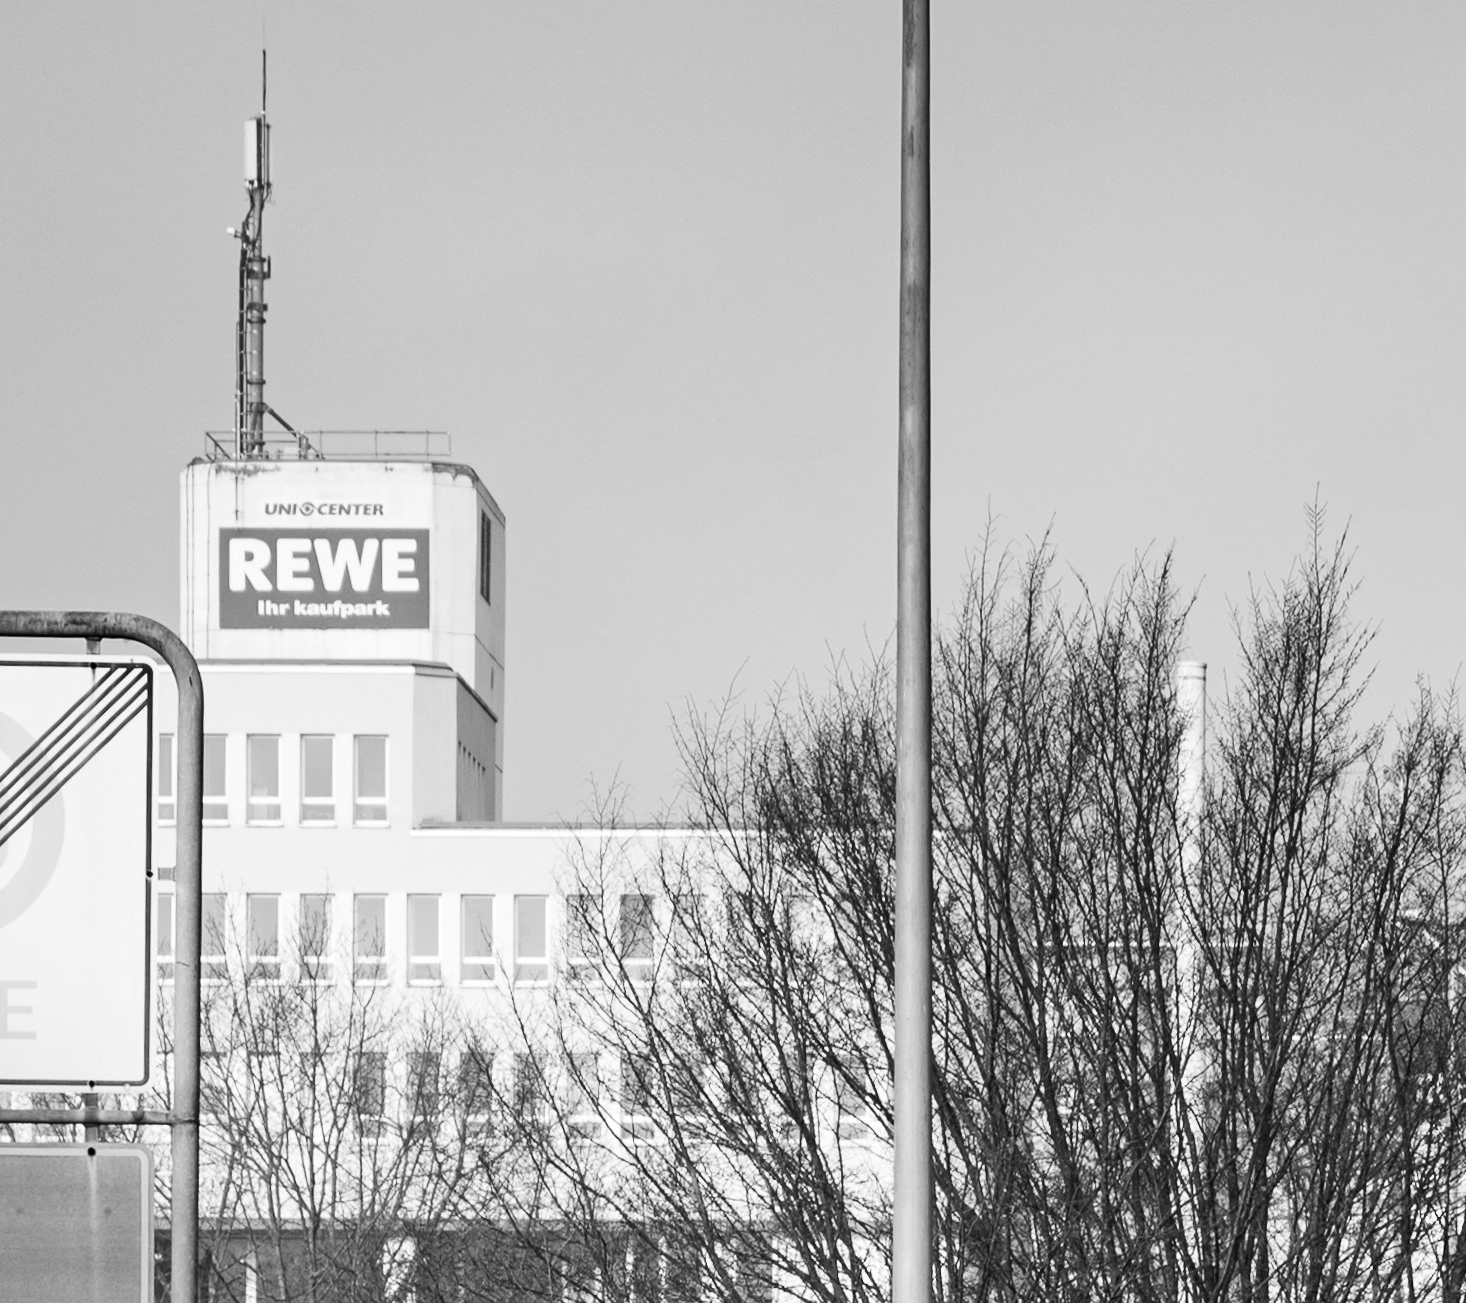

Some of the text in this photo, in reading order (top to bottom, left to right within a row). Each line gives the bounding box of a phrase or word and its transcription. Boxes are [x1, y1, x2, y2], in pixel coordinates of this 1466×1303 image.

[264, 503, 385, 516] UNI CENTER
[228, 538, 420, 592] REWE
[257, 599, 391, 619] Ihr kaufpark
